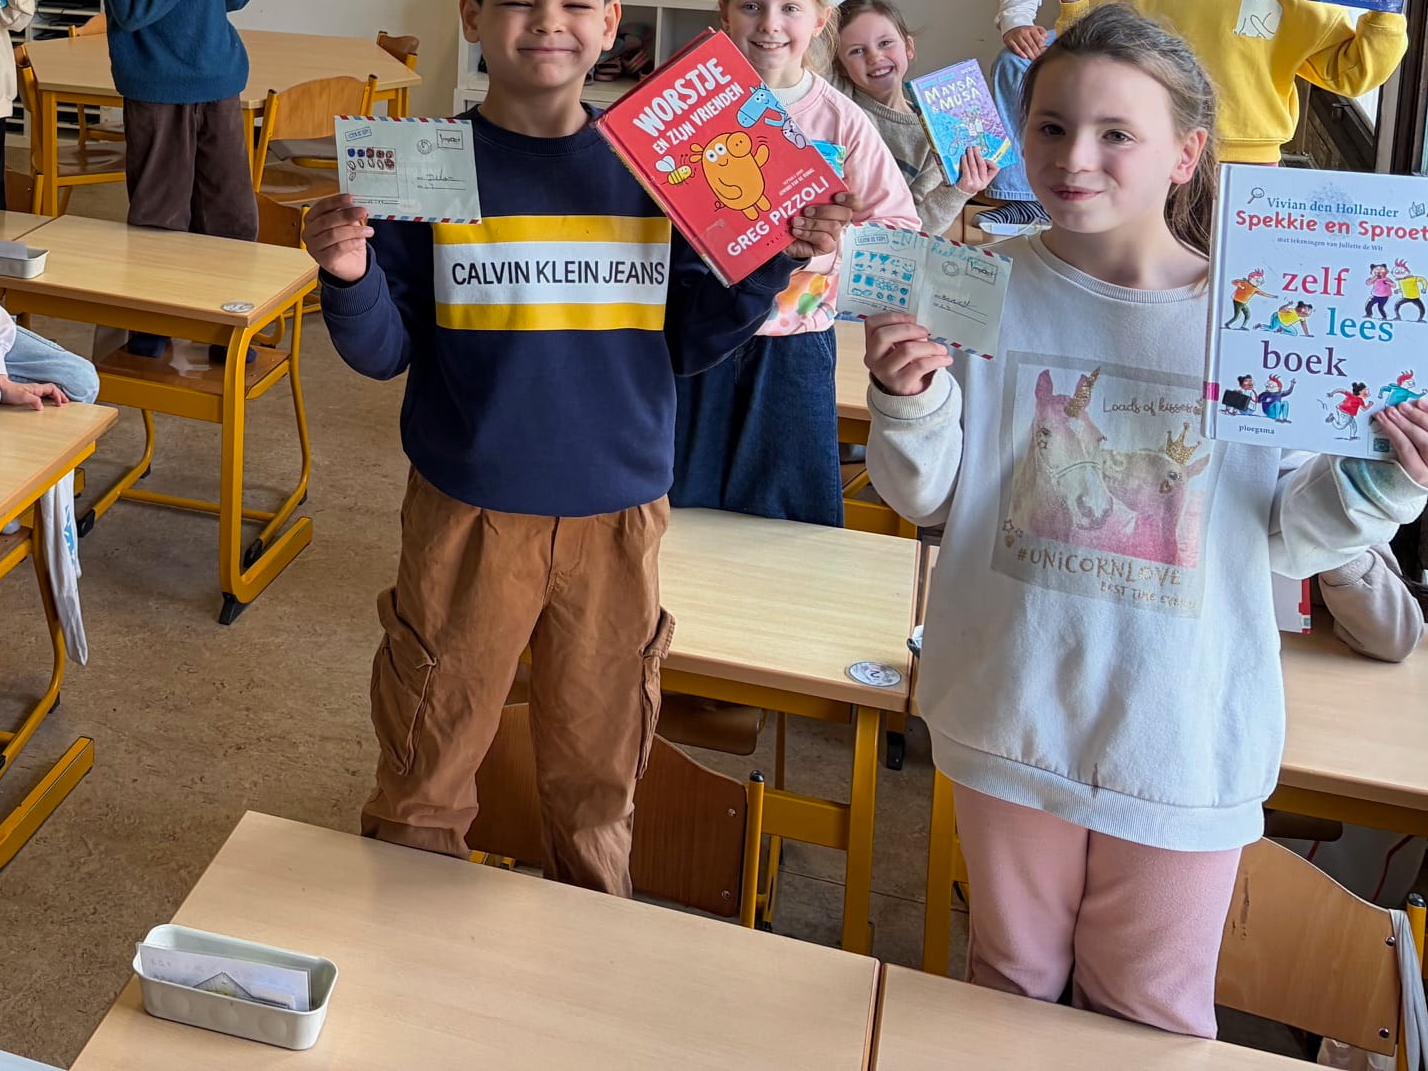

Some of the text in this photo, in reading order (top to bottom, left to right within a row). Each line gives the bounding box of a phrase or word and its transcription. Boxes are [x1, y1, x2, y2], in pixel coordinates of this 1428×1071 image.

[632, 57, 733, 138] WORSTJE
[923, 75, 976, 105] MAYSA
[939, 88, 981, 111] MUSA
[652, 81, 746, 155] EN ZIJN VRIENDEN
[726, 217, 771, 258] GREG
[769, 175, 830, 227] PIZZOLI
[1267, 197, 1400, 218] Vivian den Hollander
[1235, 210, 1428, 241] Spekkie en Sproet
[452, 260, 665, 285] CALVIN KLEIN JEANS
[1282, 267, 1351, 297] zelf
[1325, 307, 1394, 342] lees
[1260, 340, 1348, 377] boek
[1103, 397, 1140, 414] Loads
[1143, 401, 1156, 417] of
[1238, 423, 1275, 435] ploegsma
